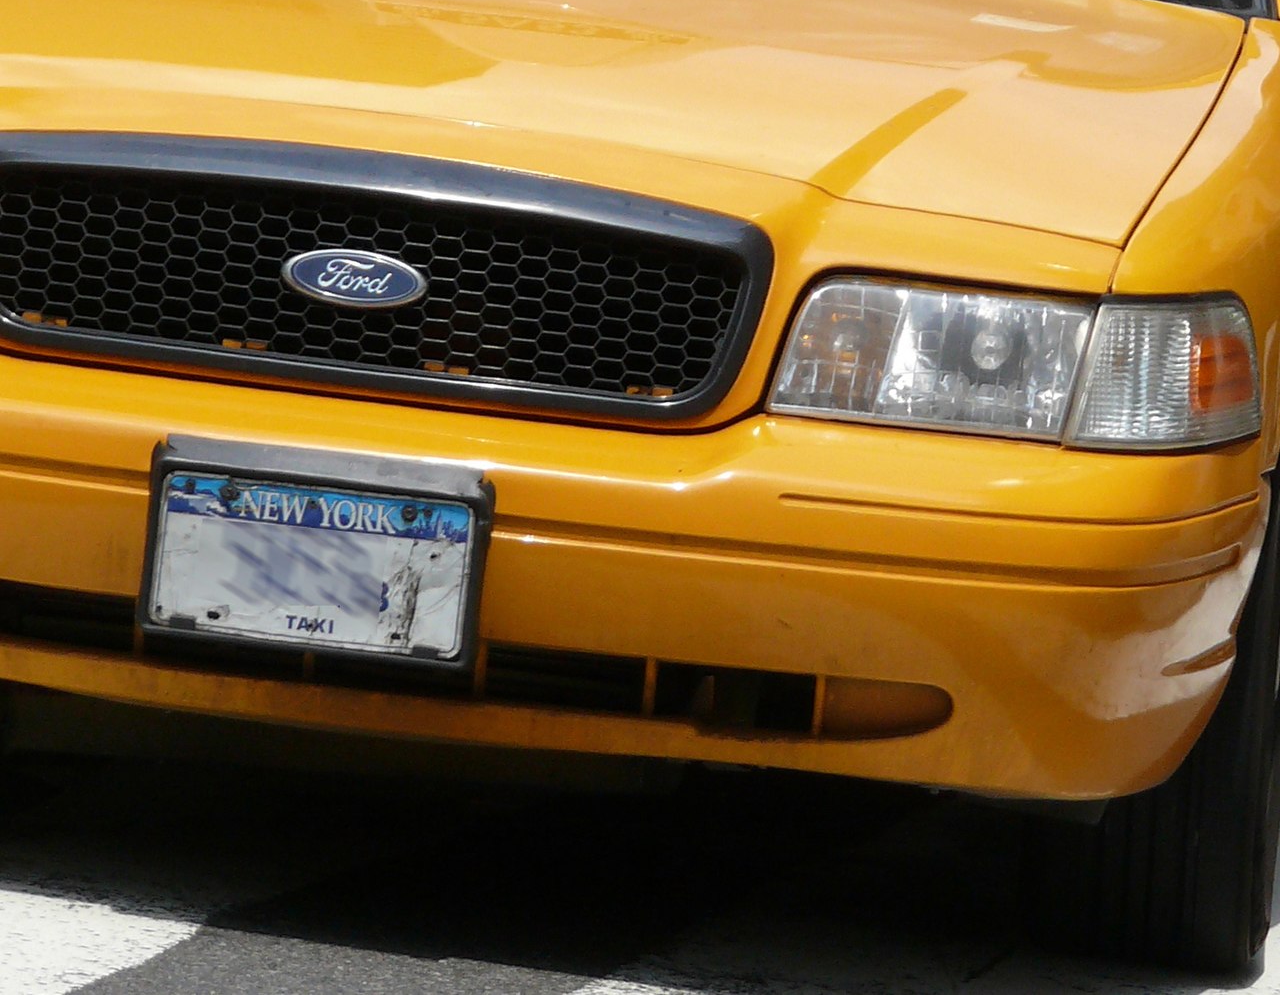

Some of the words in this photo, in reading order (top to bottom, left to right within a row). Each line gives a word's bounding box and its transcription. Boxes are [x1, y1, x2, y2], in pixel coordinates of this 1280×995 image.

[317, 258, 393, 294] Ford
[239, 490, 310, 524] NEW
[318, 496, 396, 535] YORK
[286, 614, 334, 635] TAXI
